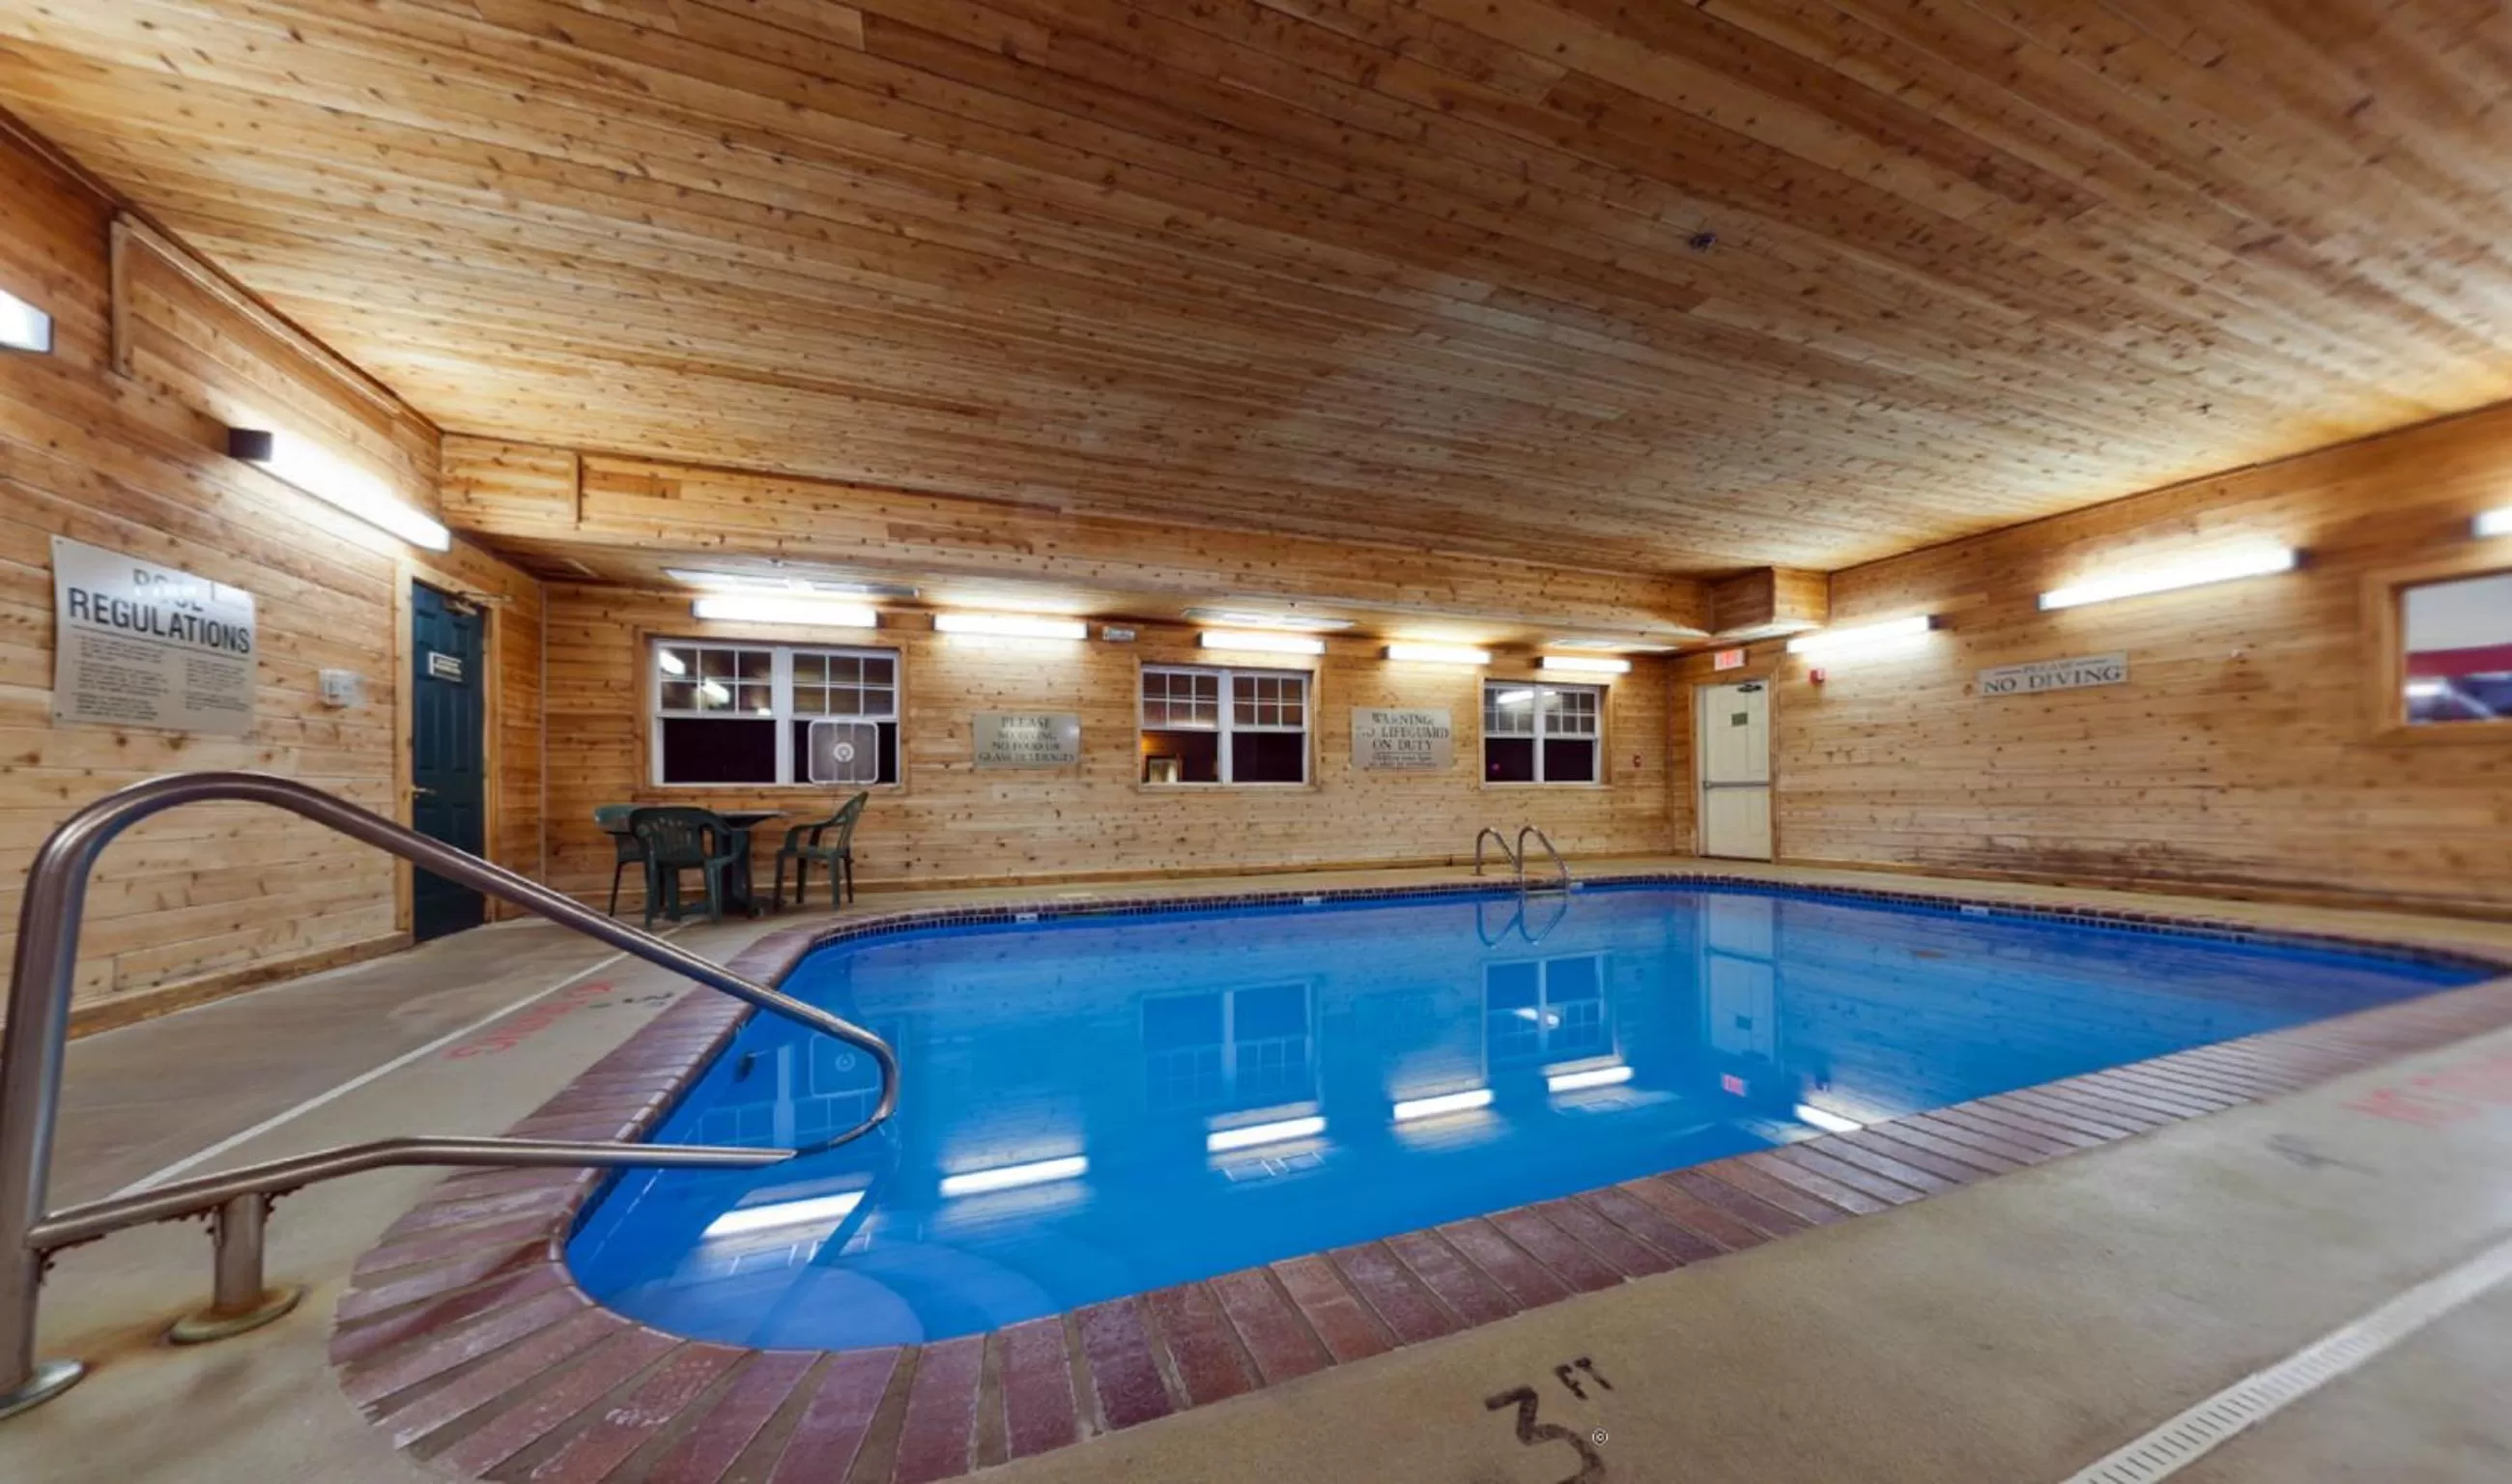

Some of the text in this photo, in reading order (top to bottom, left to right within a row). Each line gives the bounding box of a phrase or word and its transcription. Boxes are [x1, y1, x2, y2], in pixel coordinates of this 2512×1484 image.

[68, 586, 250, 654] REGULATIONS
[1984, 665, 2121, 693] NO DIVING
[1372, 739, 1433, 751] ON DUTY
[1382, 727, 1449, 739] LIFEGUARD
[1484, 1384, 1607, 1484] 3
